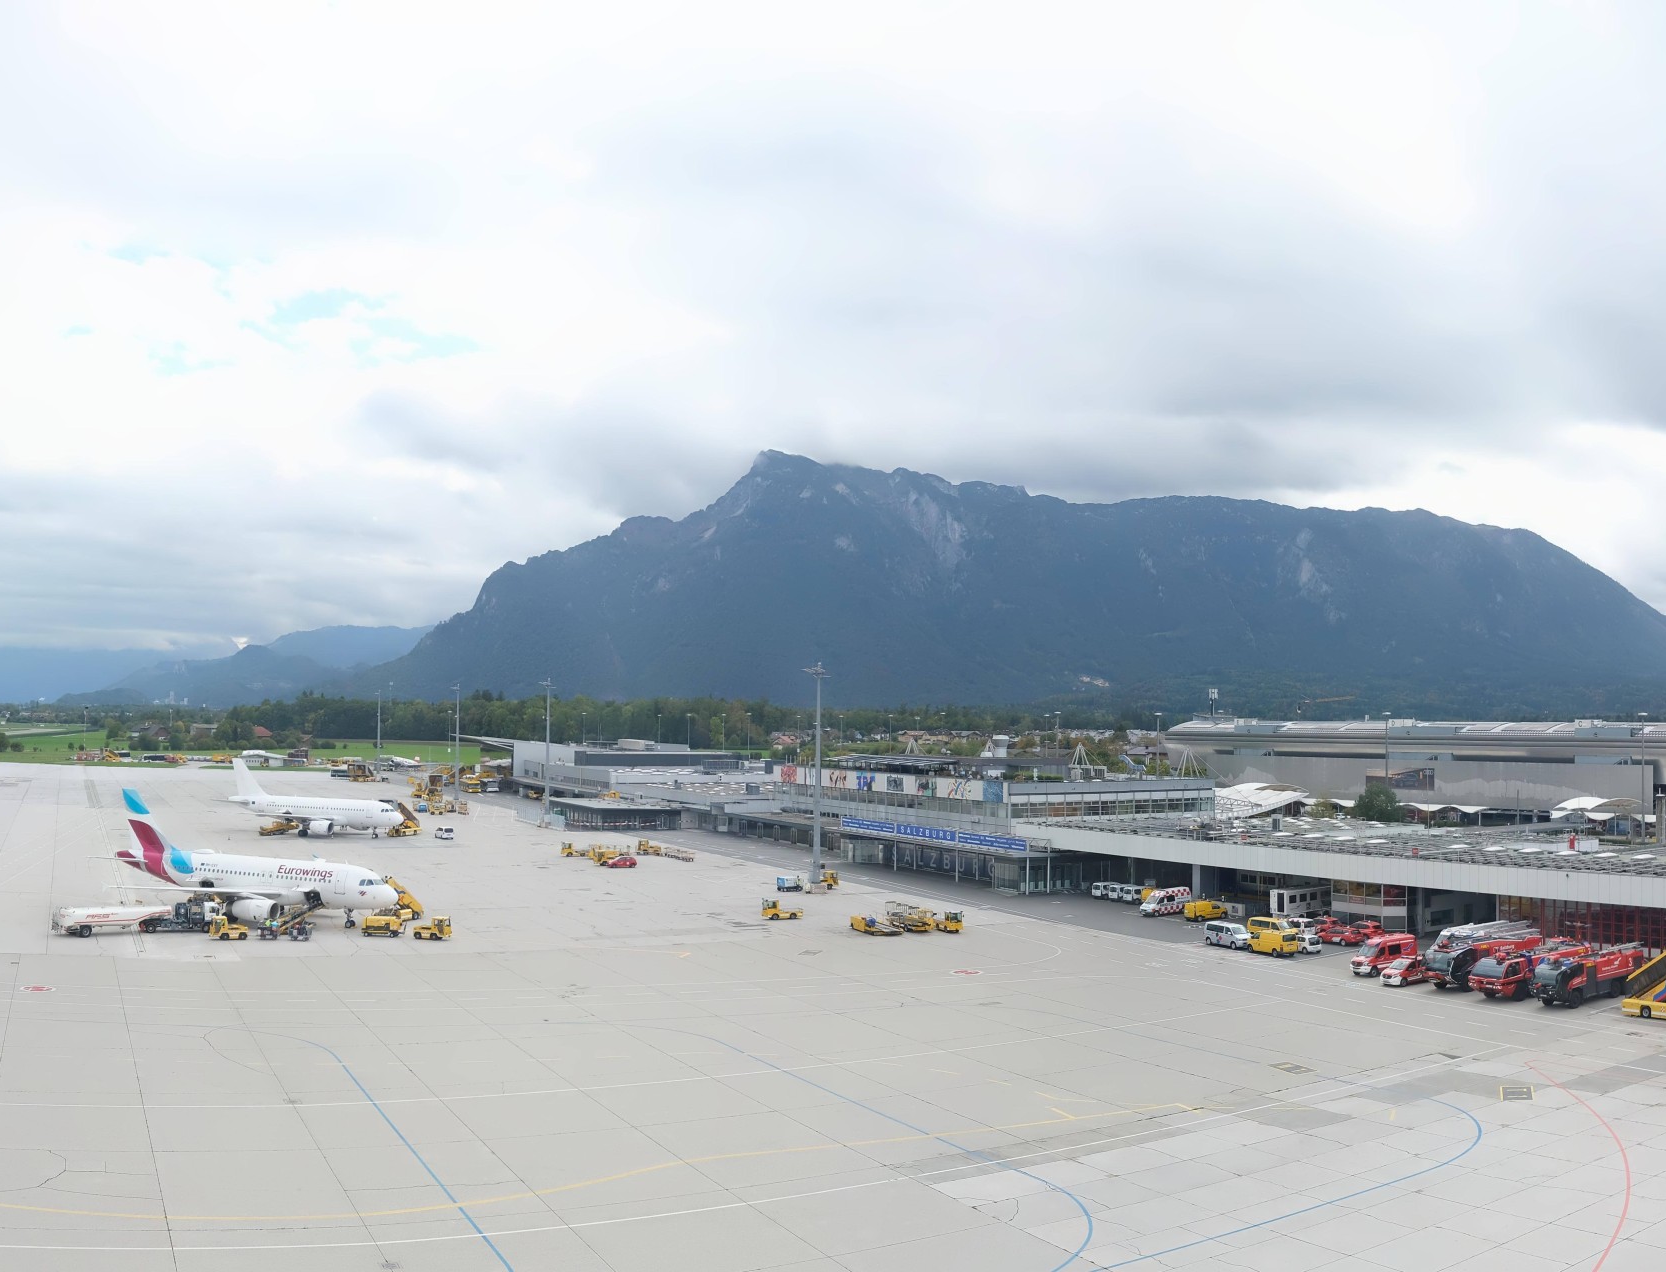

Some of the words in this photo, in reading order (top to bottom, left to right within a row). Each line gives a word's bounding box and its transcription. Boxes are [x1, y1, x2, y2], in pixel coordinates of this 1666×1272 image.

[900, 826, 951, 840] SALZBURG
[891, 846, 995, 877] SALZBURG
[277, 864, 334, 880] Eurowings
[1628, 957, 1633, 966] 3
